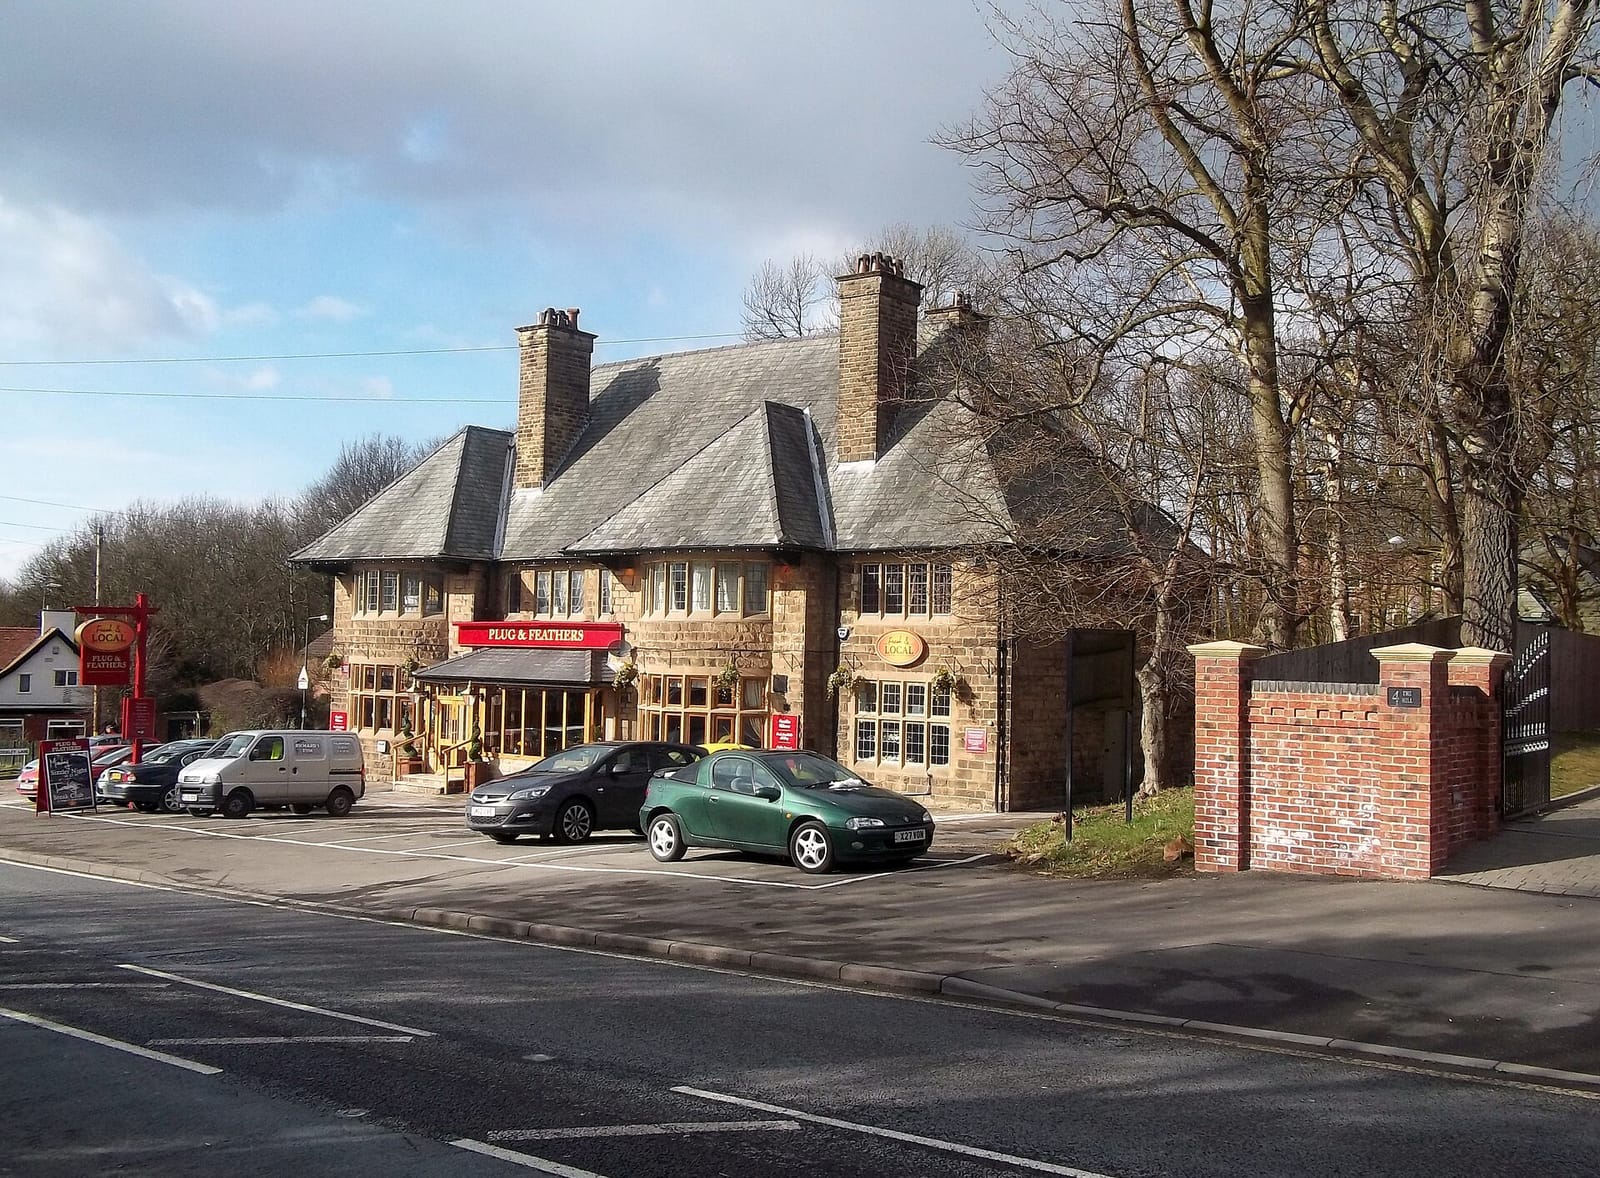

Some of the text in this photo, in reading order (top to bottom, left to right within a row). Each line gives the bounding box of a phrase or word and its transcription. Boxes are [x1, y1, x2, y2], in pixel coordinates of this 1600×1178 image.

[92, 634, 124, 642] LOCAL
[488, 629, 584, 641] PLUG & FEATHERS
[885, 646, 914, 654] LOCAL
[1392, 690, 1400, 706] 4
